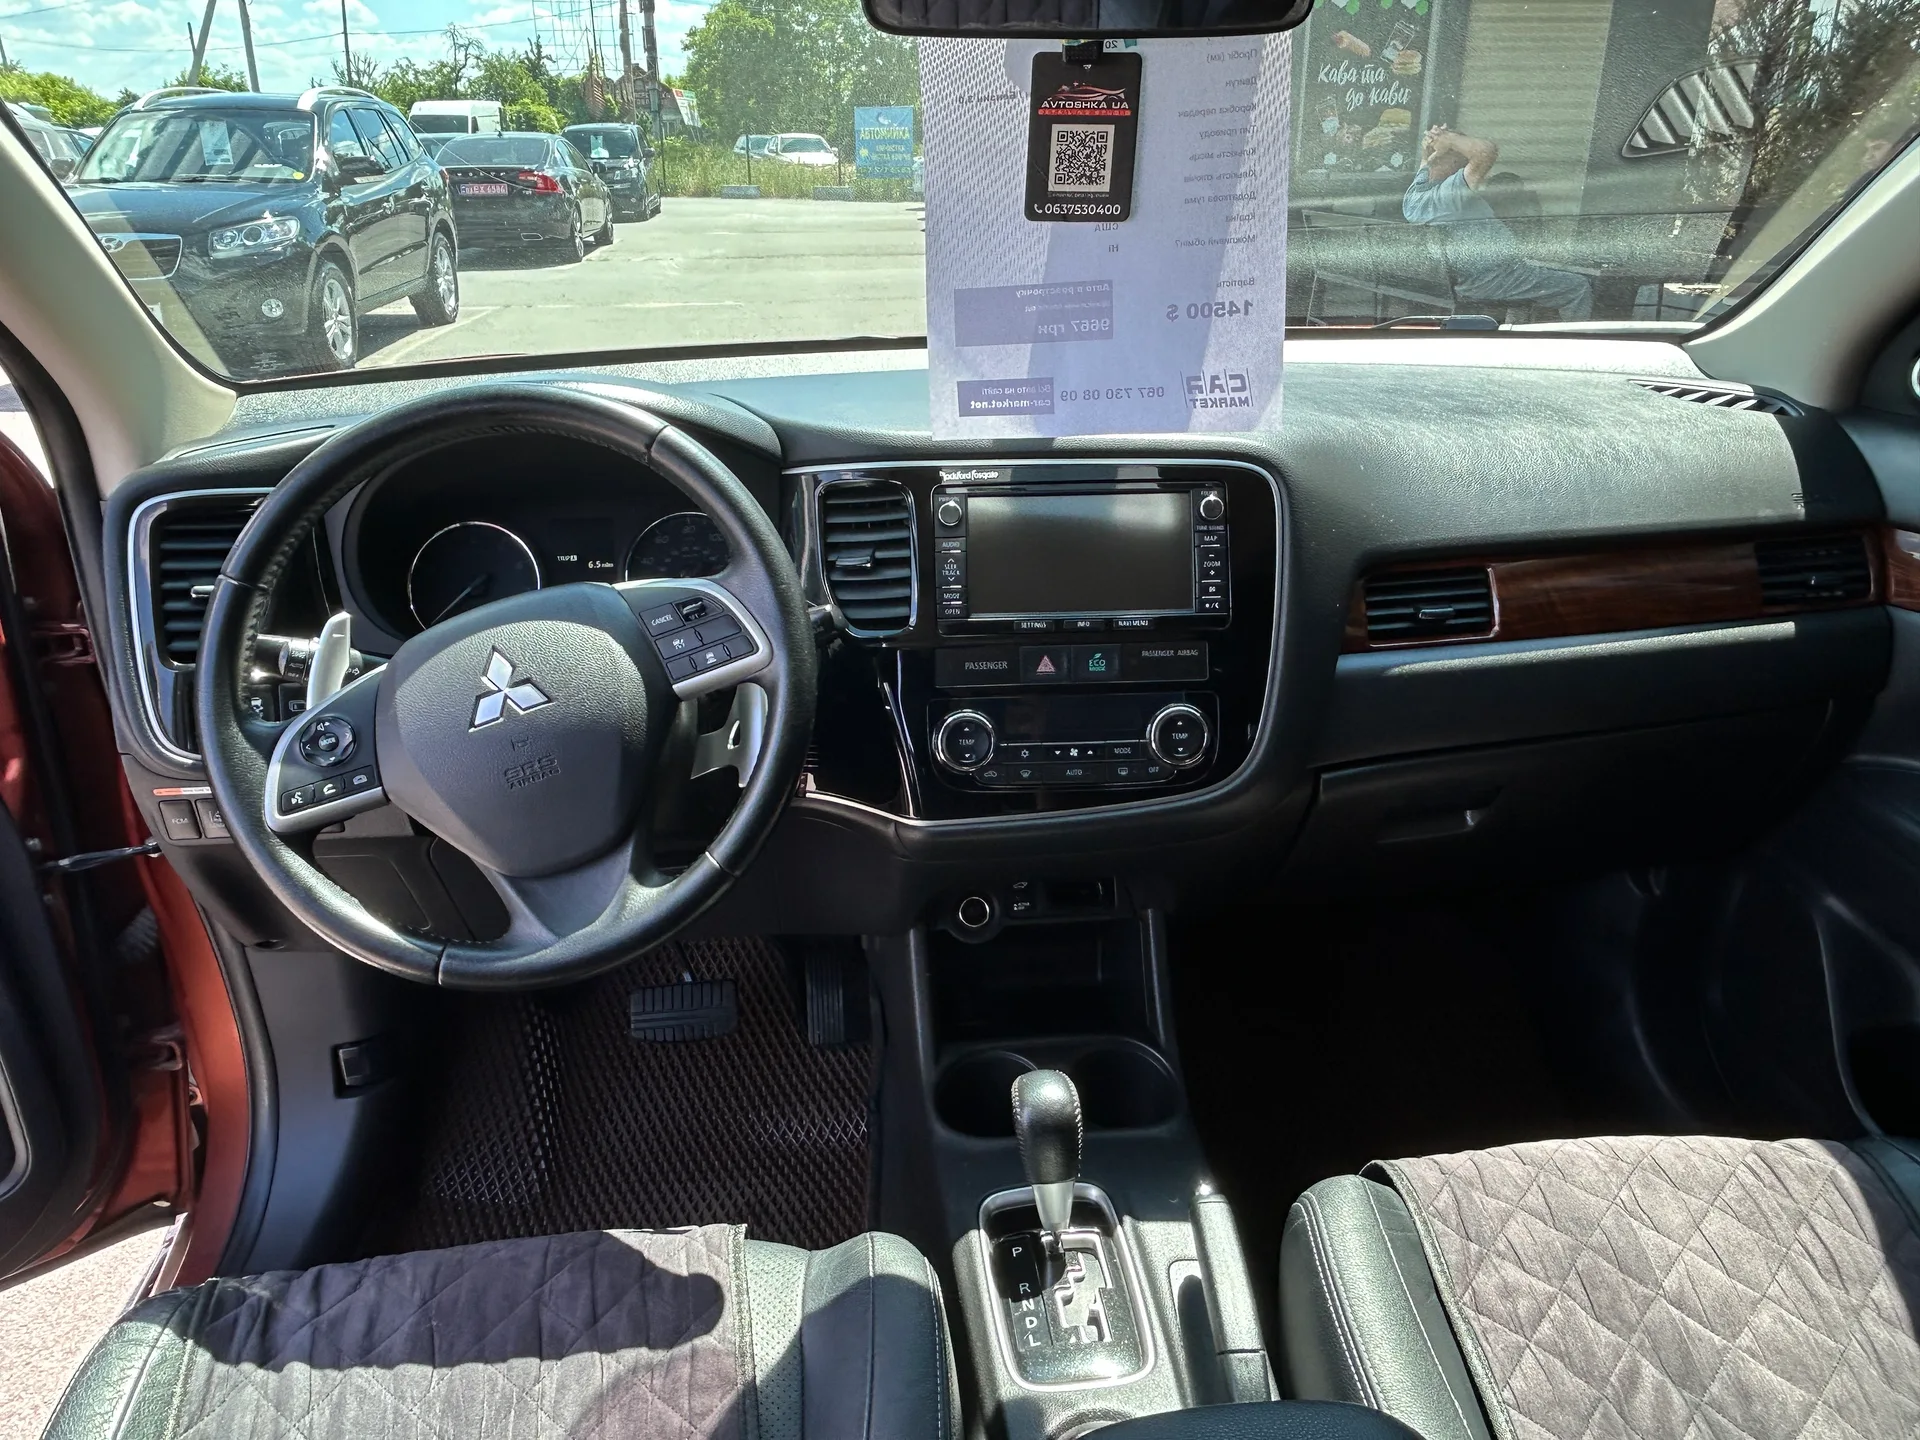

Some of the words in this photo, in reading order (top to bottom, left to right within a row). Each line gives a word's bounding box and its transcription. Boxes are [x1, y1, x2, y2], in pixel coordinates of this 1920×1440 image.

[1318, 60, 1358, 85] Кава
[1369, 80, 1412, 106] кави
[1041, 101, 1107, 109] AVTOSHKA
[1044, 203, 1121, 215] 0637530400
[588, 560, 601, 569] 6.5
[651, 614, 674, 627] CANCEL
[1141, 649, 1175, 657] PASSENGER
[964, 661, 1008, 670] PASSENGER
[1088, 659, 1106, 667] ECO
[1012, 1246, 1022, 1257] P
[1019, 1282, 1031, 1294] R
[1021, 1299, 1035, 1311] N
[1026, 1316, 1038, 1328] D
[1028, 1334, 1041, 1347] L
